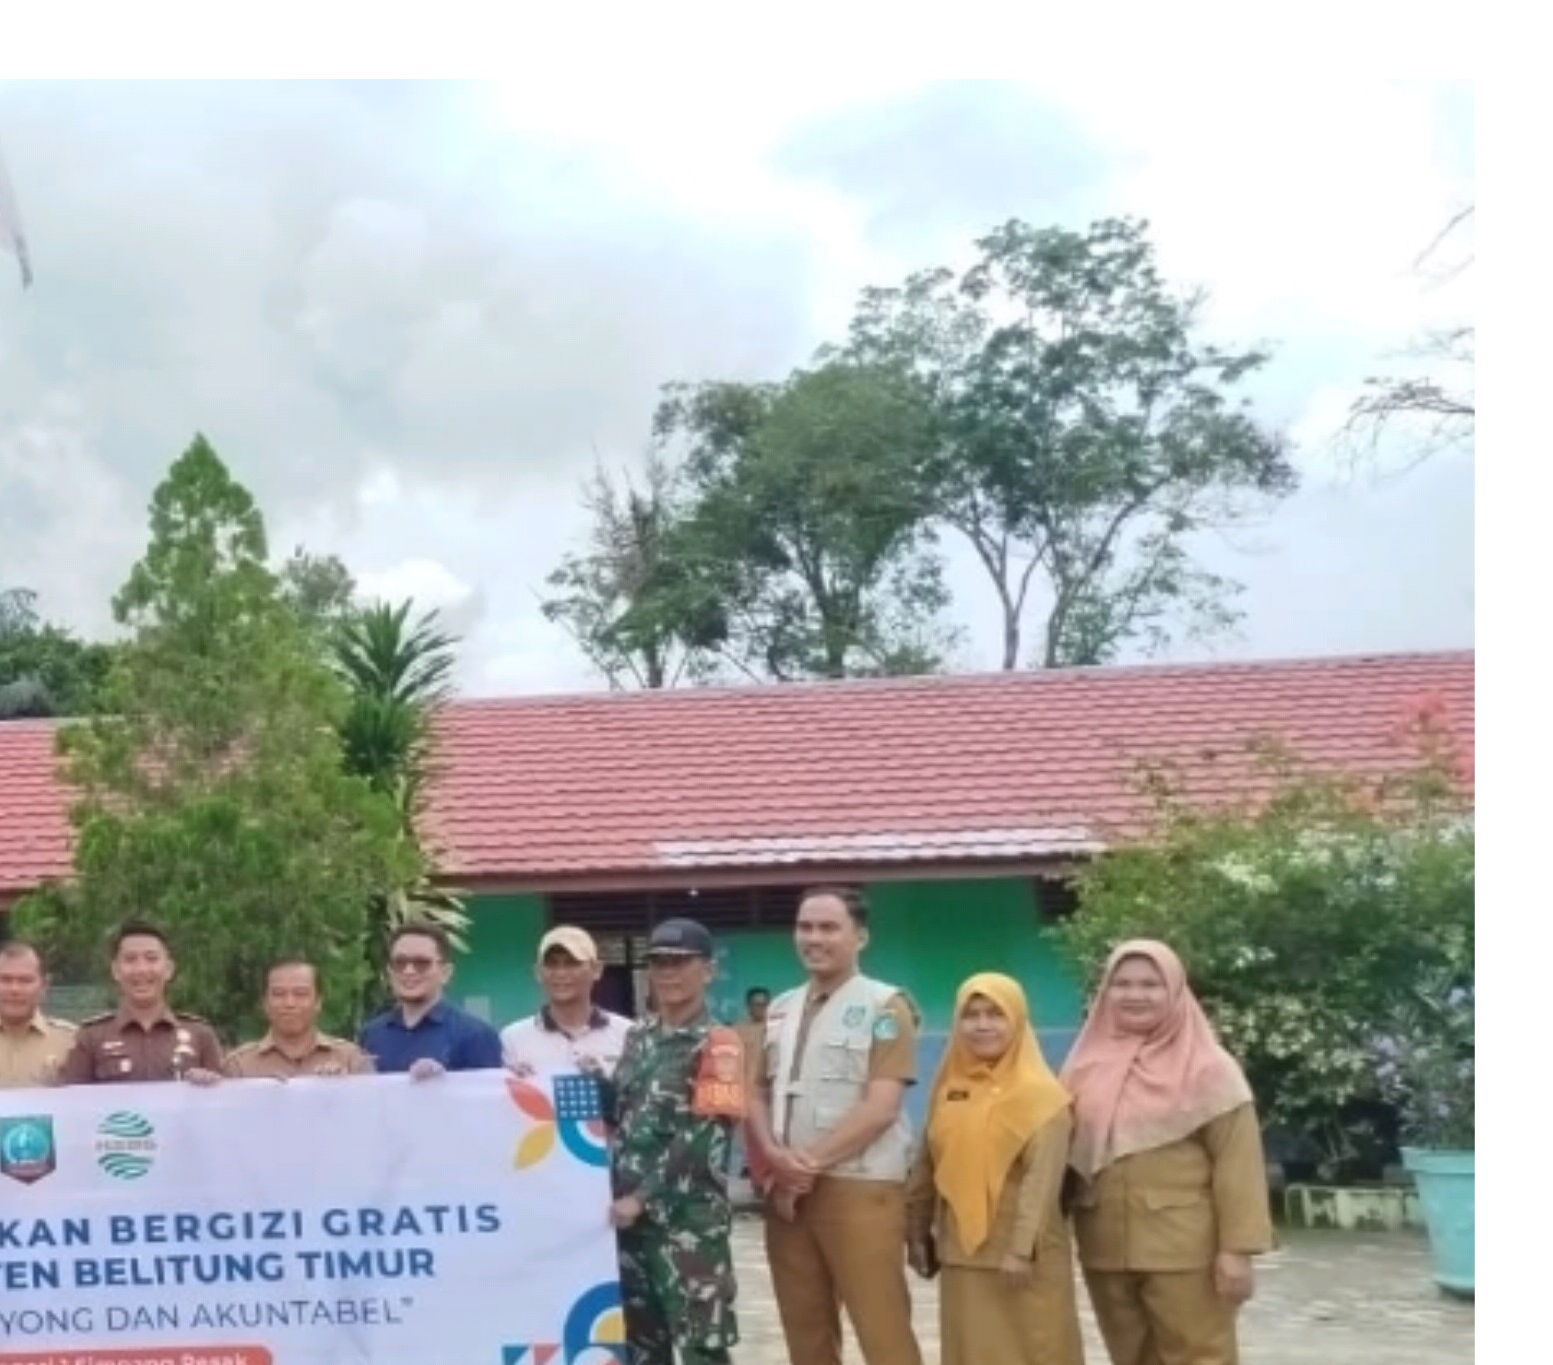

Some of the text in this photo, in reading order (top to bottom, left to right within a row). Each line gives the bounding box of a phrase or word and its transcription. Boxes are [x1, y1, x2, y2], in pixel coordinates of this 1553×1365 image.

[110, 1209, 303, 1245] BERGIZI
[322, 1203, 502, 1238] GRATIS
[74, 1251, 285, 1288] BELITUNG
[296, 1247, 437, 1280] TIMUR
[107, 1304, 179, 1332] DAN
